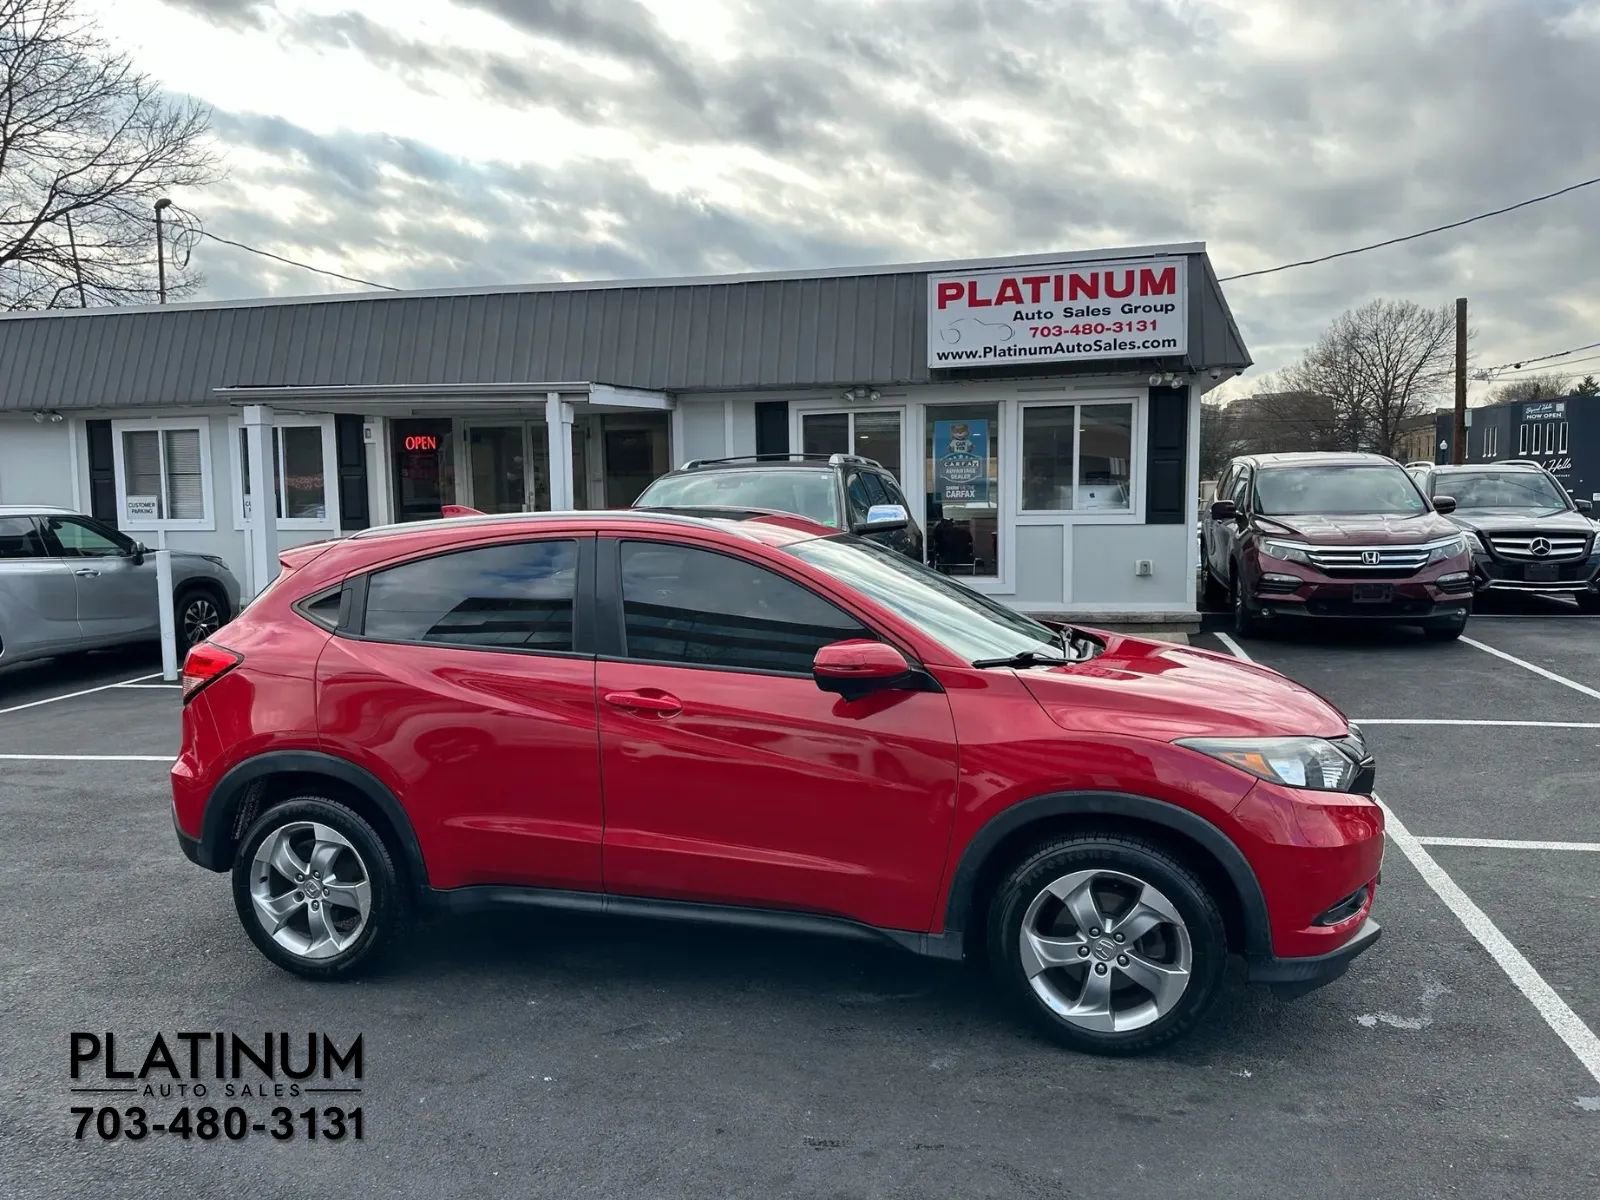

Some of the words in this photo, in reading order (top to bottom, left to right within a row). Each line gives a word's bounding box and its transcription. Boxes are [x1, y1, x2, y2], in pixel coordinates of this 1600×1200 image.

[937, 266, 1176, 310] PLATINUM
[1012, 309, 1054, 322] Auto
[1062, 305, 1111, 318] Sales
[1120, 302, 1175, 316] Group
[1029, 319, 1157, 338] 703-480-3131
[936, 336, 1177, 361] www.PlatinumAutoSales.com
[405, 435, 437, 450] OPEN
